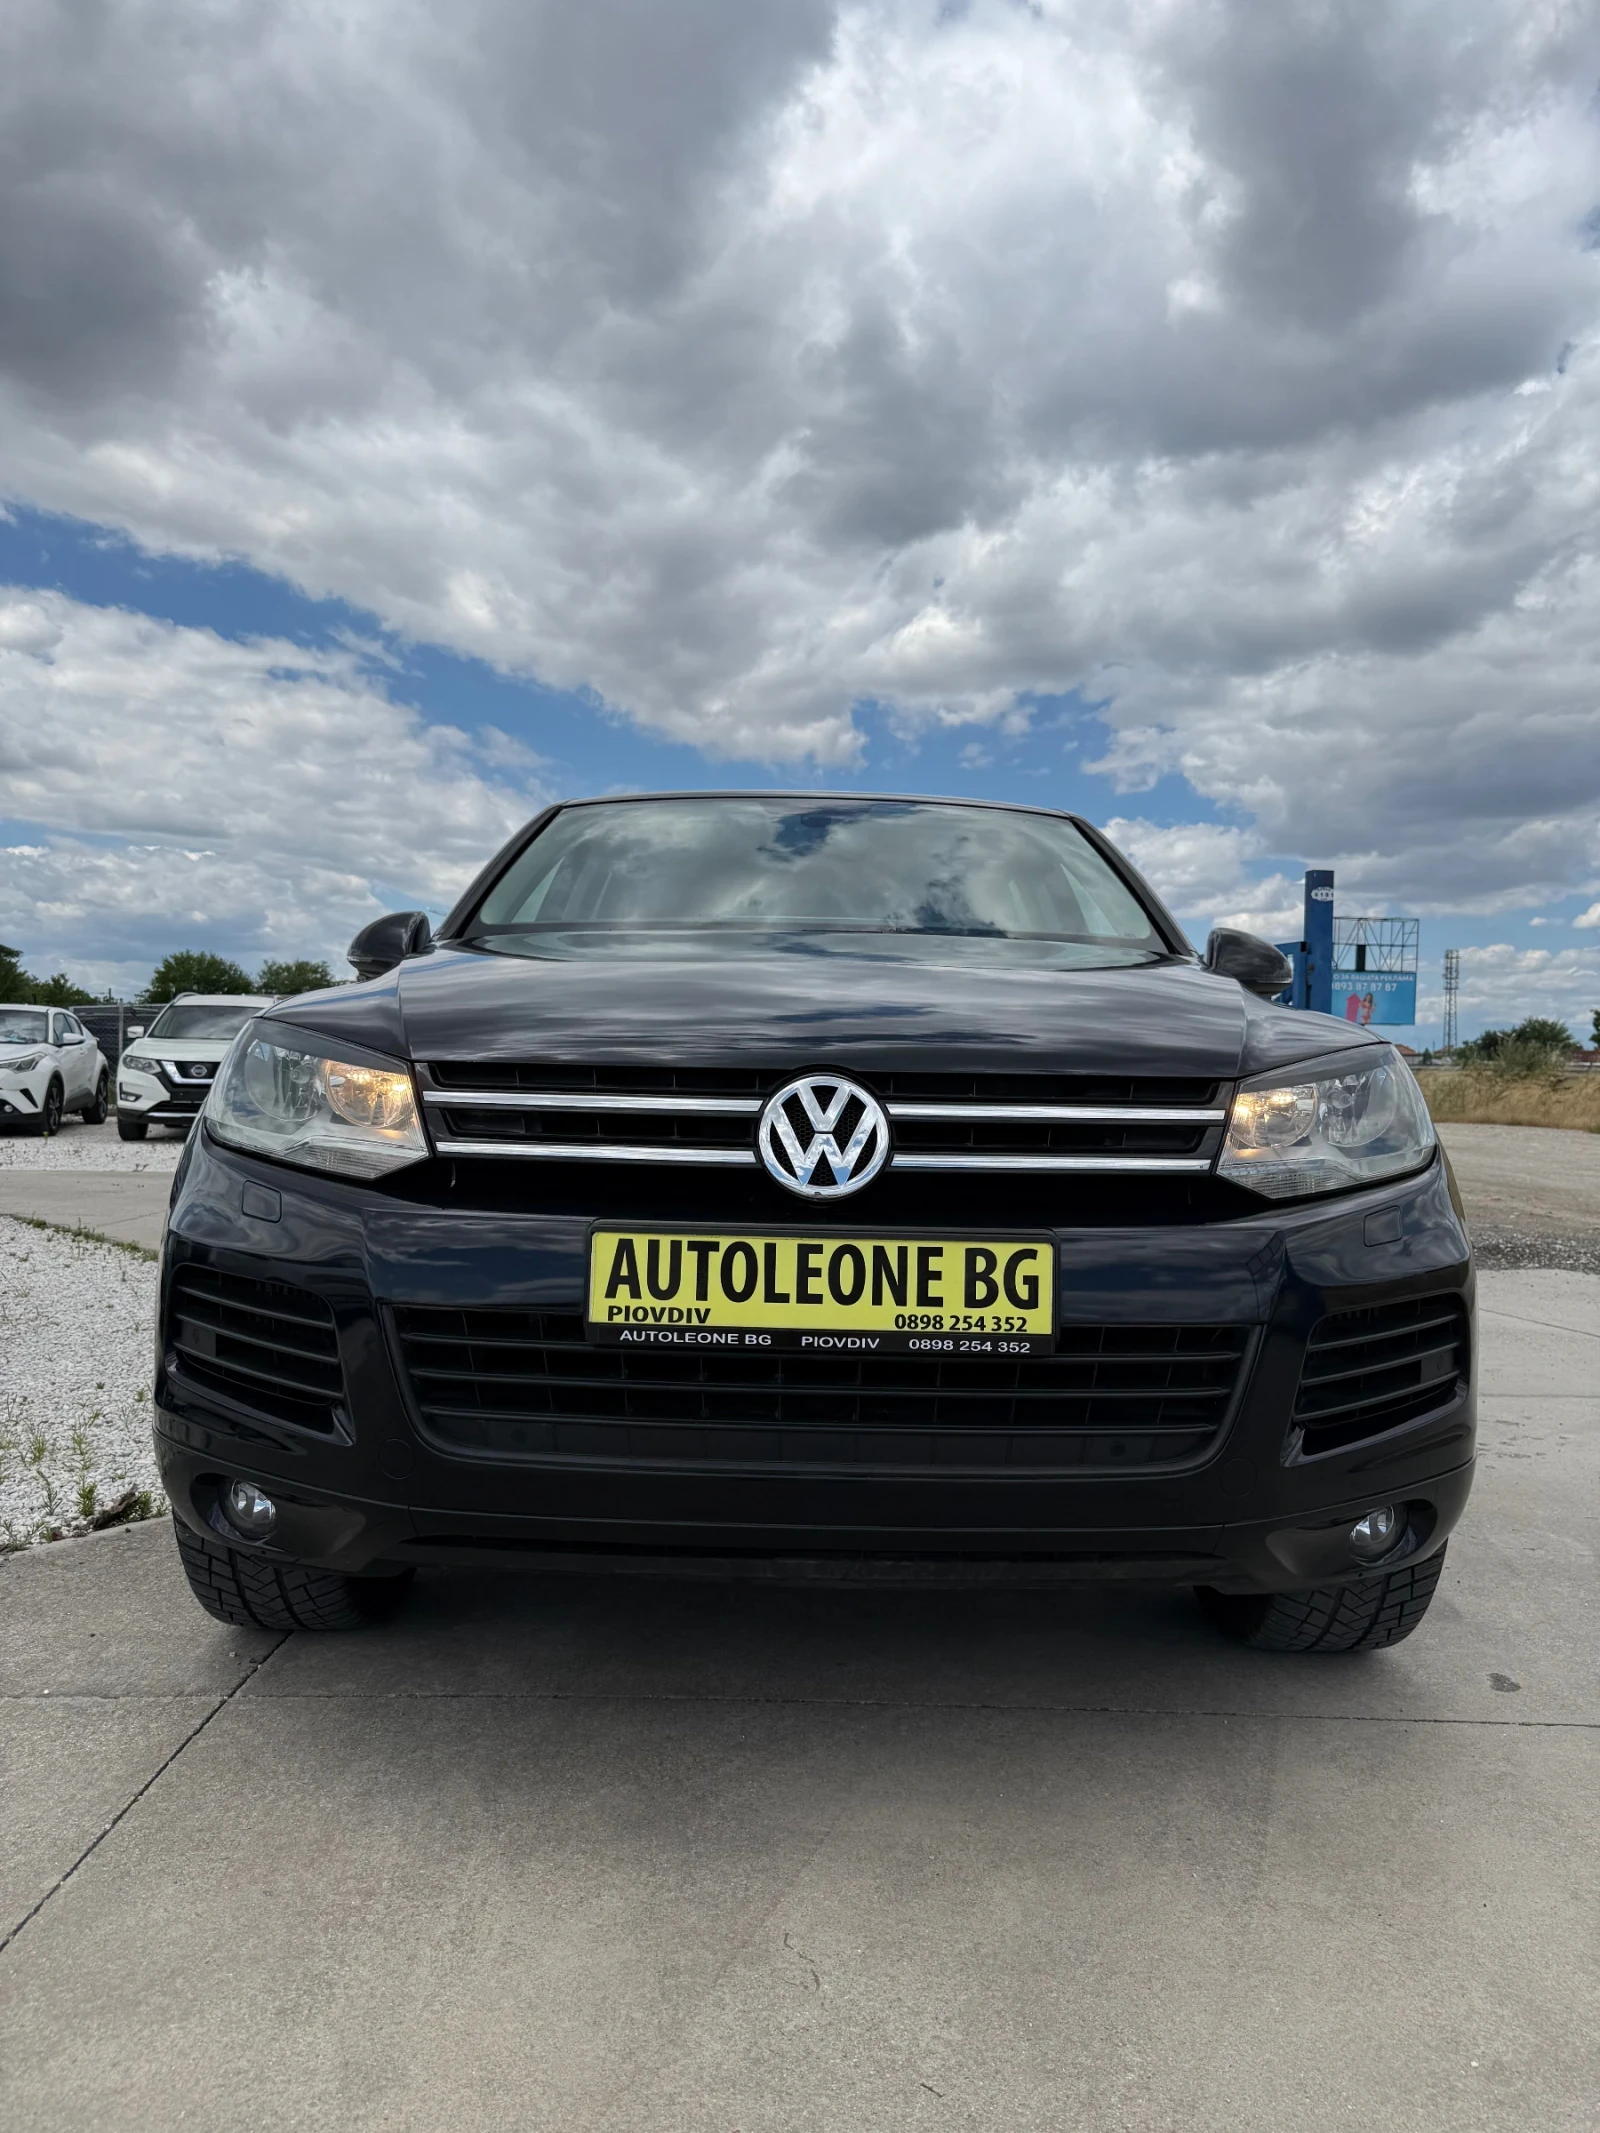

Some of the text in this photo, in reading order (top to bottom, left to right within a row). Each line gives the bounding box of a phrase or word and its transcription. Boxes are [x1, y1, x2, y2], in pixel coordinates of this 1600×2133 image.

[1331, 982, 1397, 992] 893 87 87 87
[604, 1237, 1040, 1311] AUTOLEONE BG
[607, 1305, 712, 1324] PIOVDIV
[894, 1313, 1028, 1333] 0898 254 352
[619, 1330, 772, 1346] AUTOLEONE BG
[801, 1335, 880, 1349] PIOVDIV
[908, 1338, 1031, 1354] 0898 254 352
